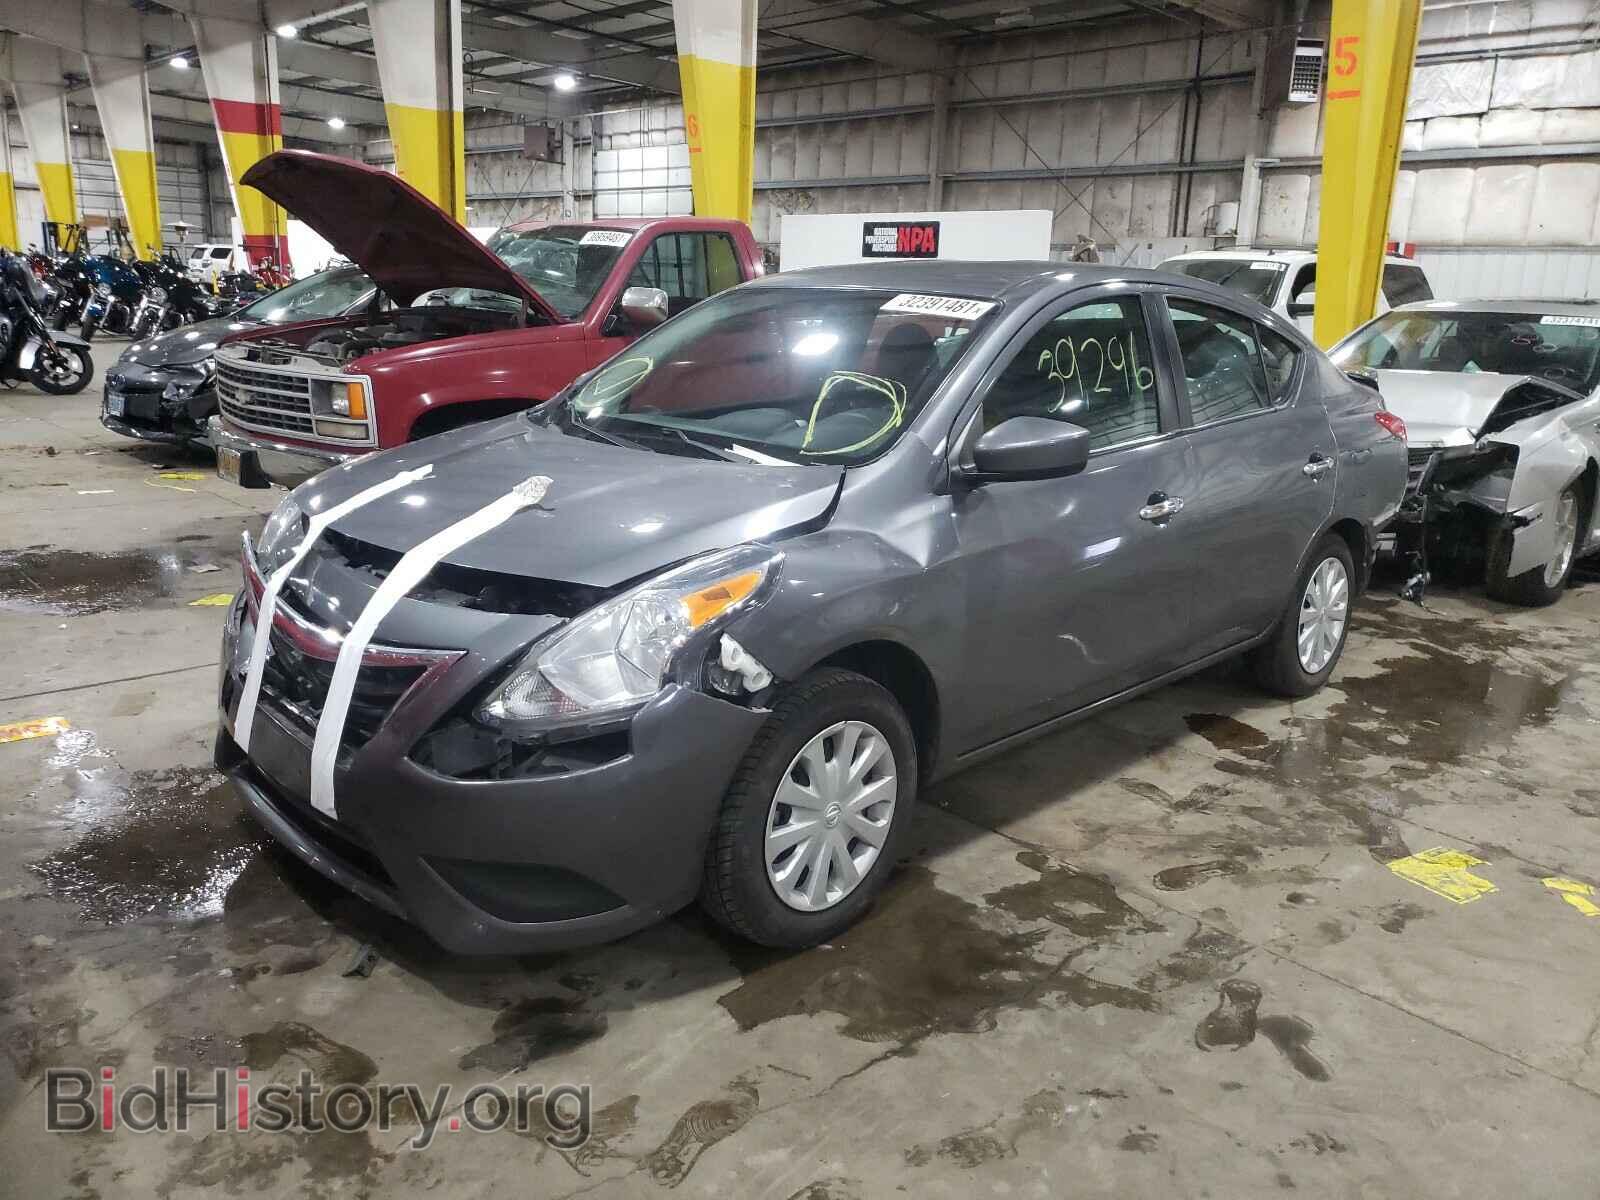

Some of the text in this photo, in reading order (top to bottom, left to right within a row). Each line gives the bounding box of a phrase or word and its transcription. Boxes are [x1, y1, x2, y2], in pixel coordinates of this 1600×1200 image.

[1335, 36, 1360, 77] 5
[898, 225, 936, 252] NPA
[1037, 331, 1154, 414] 39296
